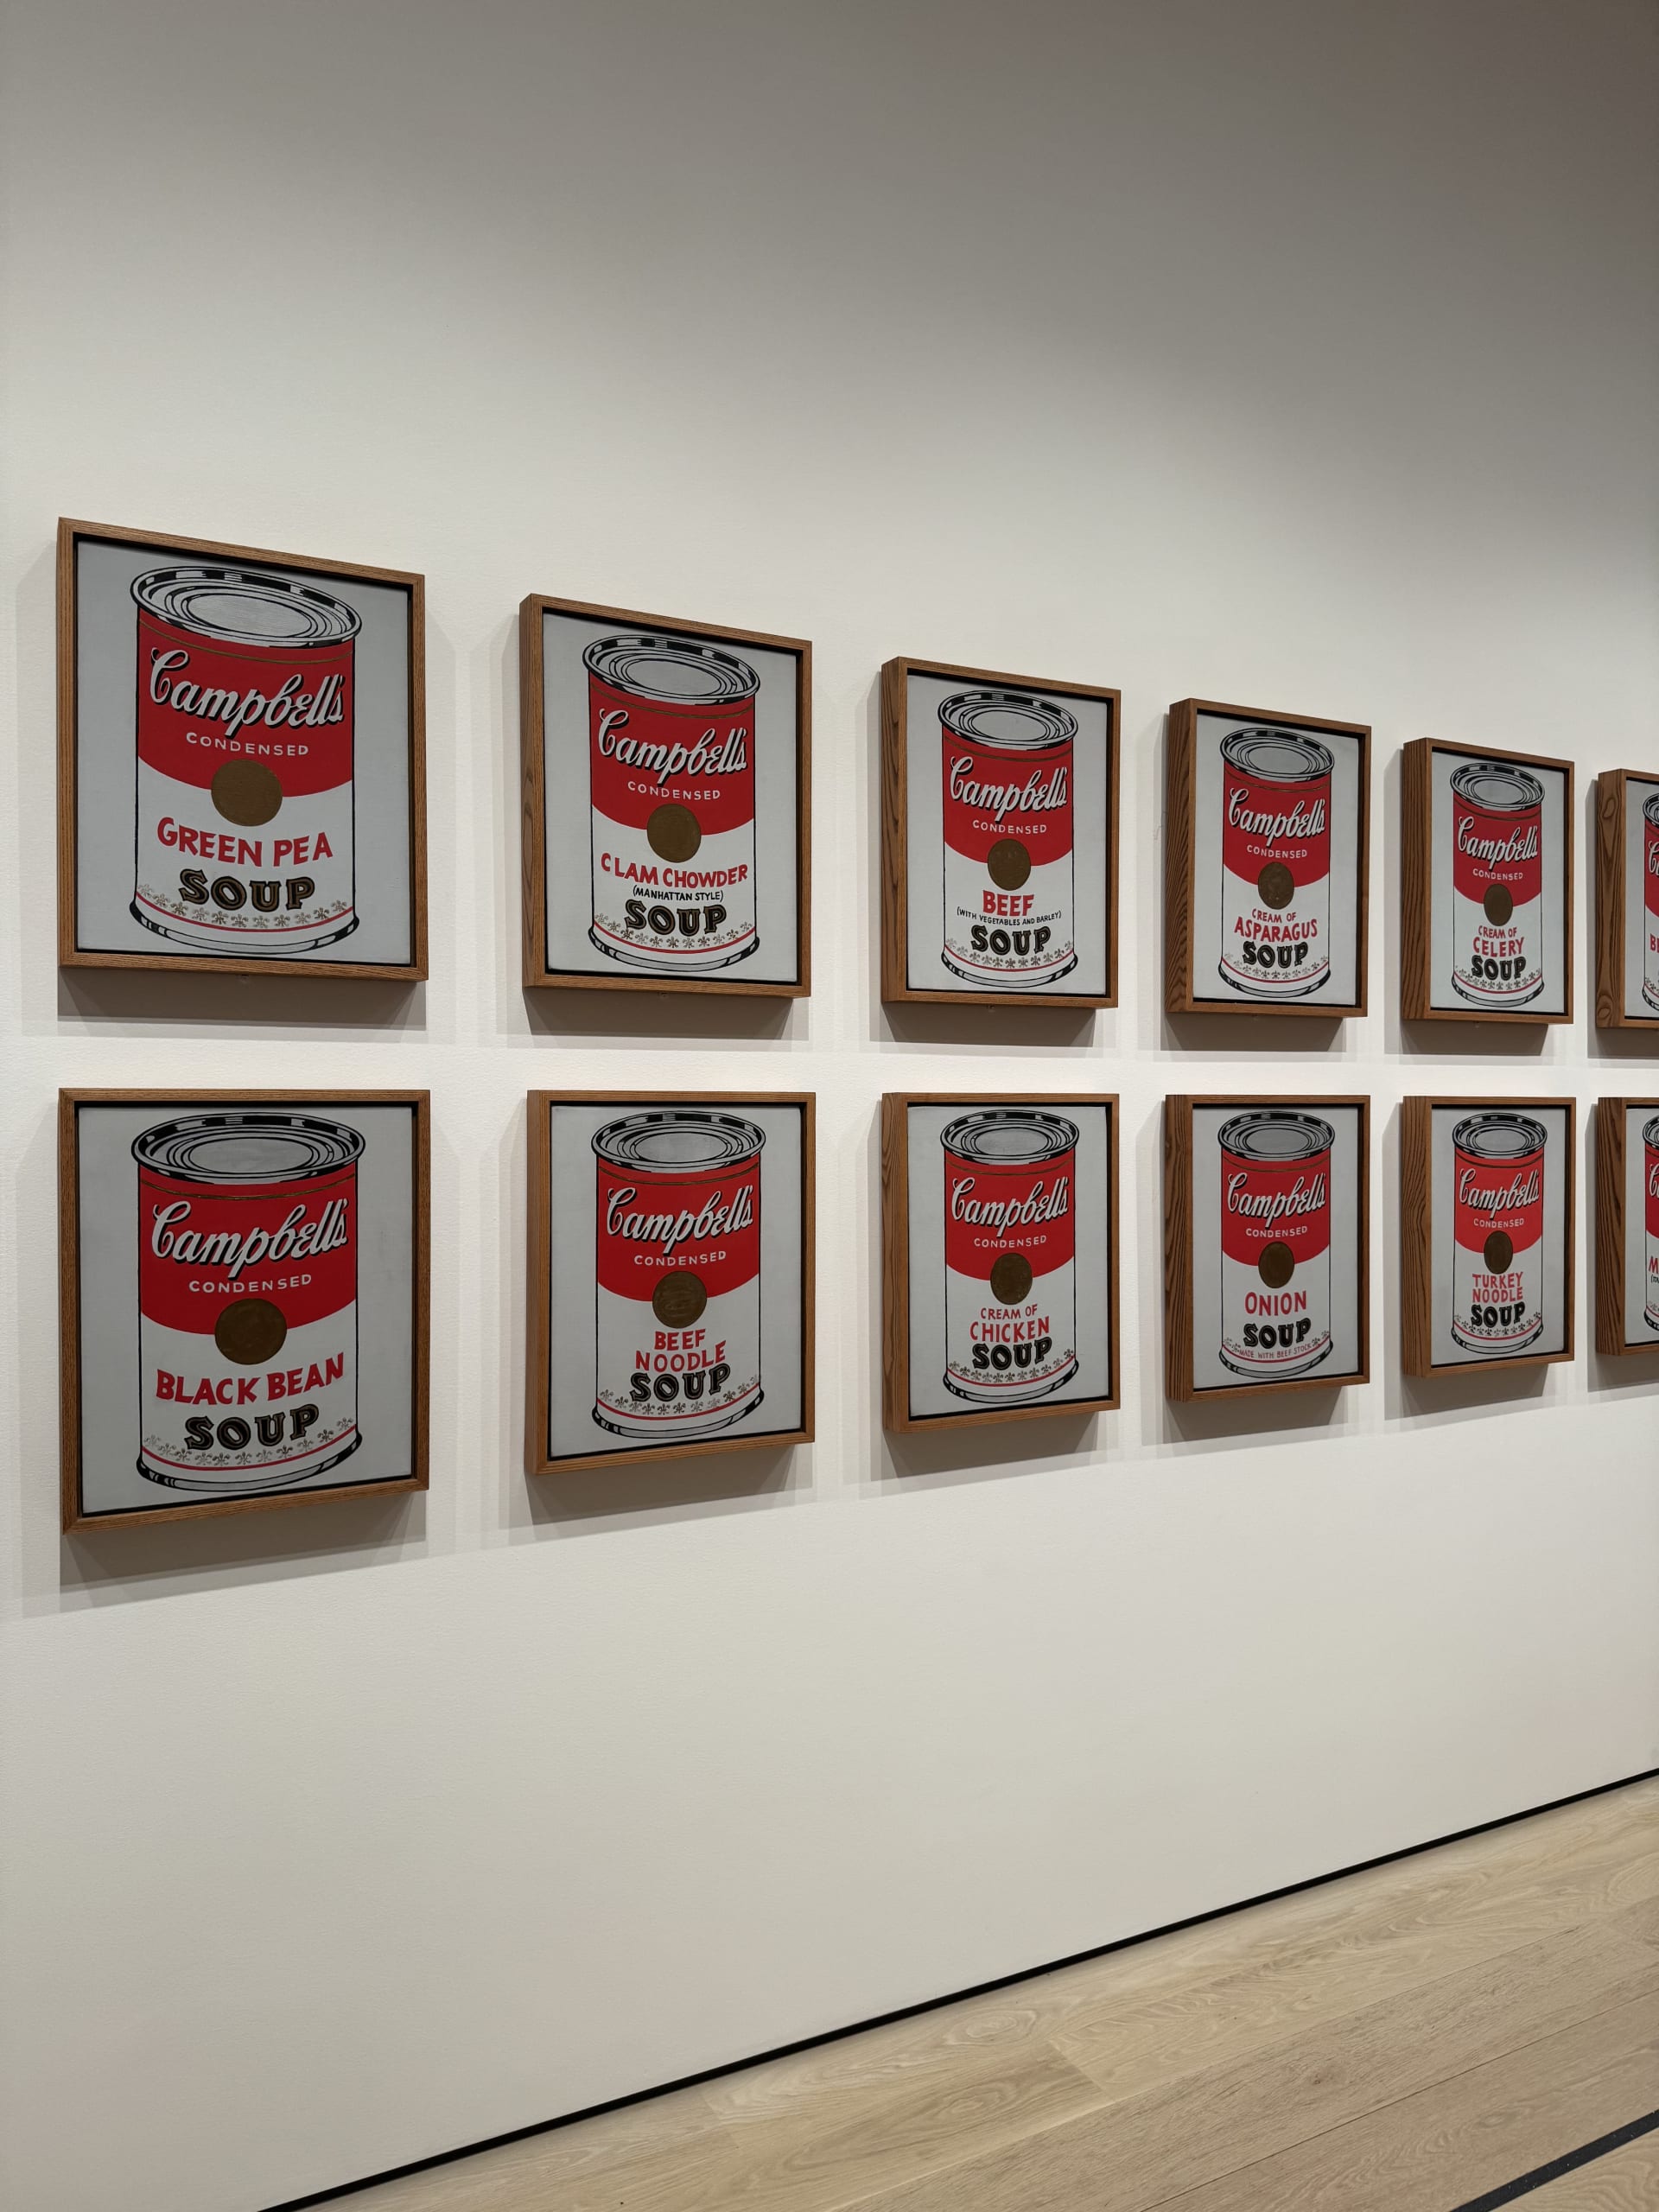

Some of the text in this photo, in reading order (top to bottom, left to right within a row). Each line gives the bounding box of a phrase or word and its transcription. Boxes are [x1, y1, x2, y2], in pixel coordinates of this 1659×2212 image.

[148, 646, 346, 739] Campbell's
[186, 732, 309, 756] CONDENSED
[597, 709, 748, 785] Campbell's
[627, 780, 721, 800] CONDENSED
[950, 755, 1068, 823] Campbell's
[973, 820, 1047, 834] CONDENSED
[157, 817, 334, 868] GREEN PEA
[1247, 845, 1307, 858] CONDENSED
[601, 853, 748, 888] CLAM CHOWDER
[1472, 868, 1523, 880] CONDENSED
[179, 868, 315, 912] SOUP
[632, 886, 724, 901] (MANHATTAN STYLE)
[982, 890, 1034, 916] BEEF
[624, 899, 727, 936] SOUP
[957, 906, 976, 918] (WITH
[979, 915, 1020, 925] VEGETABLES
[1037, 911, 1062, 923] BARLEY)
[1251, 908, 1296, 923] CREAM OF
[970, 925, 1051, 956] SOUP
[1234, 916, 1318, 943] ASPARAGUS
[1478, 925, 1517, 938] CREAM OF
[1243, 940, 1308, 969] SOUP
[1473, 937, 1524, 957] CELERY
[1471, 955, 1527, 981] SOUP
[951, 1176, 1069, 1238] Campbell's
[606, 1185, 754, 1257] Campbell's
[1246, 1225, 1307, 1238] CONDENSED
[1473, 1217, 1524, 1229] CONDENSED
[151, 1198, 348, 1281] Campbell's
[974, 1235, 1047, 1249] CONDENSED
[633, 1250, 727, 1267] CONDENSED
[188, 1274, 312, 1294] CONDENSED
[1472, 1272, 1523, 1288] TURKEY
[1245, 1290, 1306, 1316] ONION
[1472, 1287, 1523, 1304] NOODLE
[980, 1304, 1039, 1320] CREAM OF
[1471, 1301, 1525, 1327] SOUP
[654, 1328, 706, 1351] BEEF
[969, 1316, 1050, 1343] CHICKEN
[1243, 1318, 1311, 1349] SOUP
[635, 1339, 727, 1373] NOODLE
[972, 1336, 1052, 1370] SOUP
[1294, 1344, 1312, 1355] STOCK
[156, 1352, 344, 1406] BLACK BEAN
[630, 1363, 731, 1402] SOUP
[185, 1402, 320, 1451] SOUP
